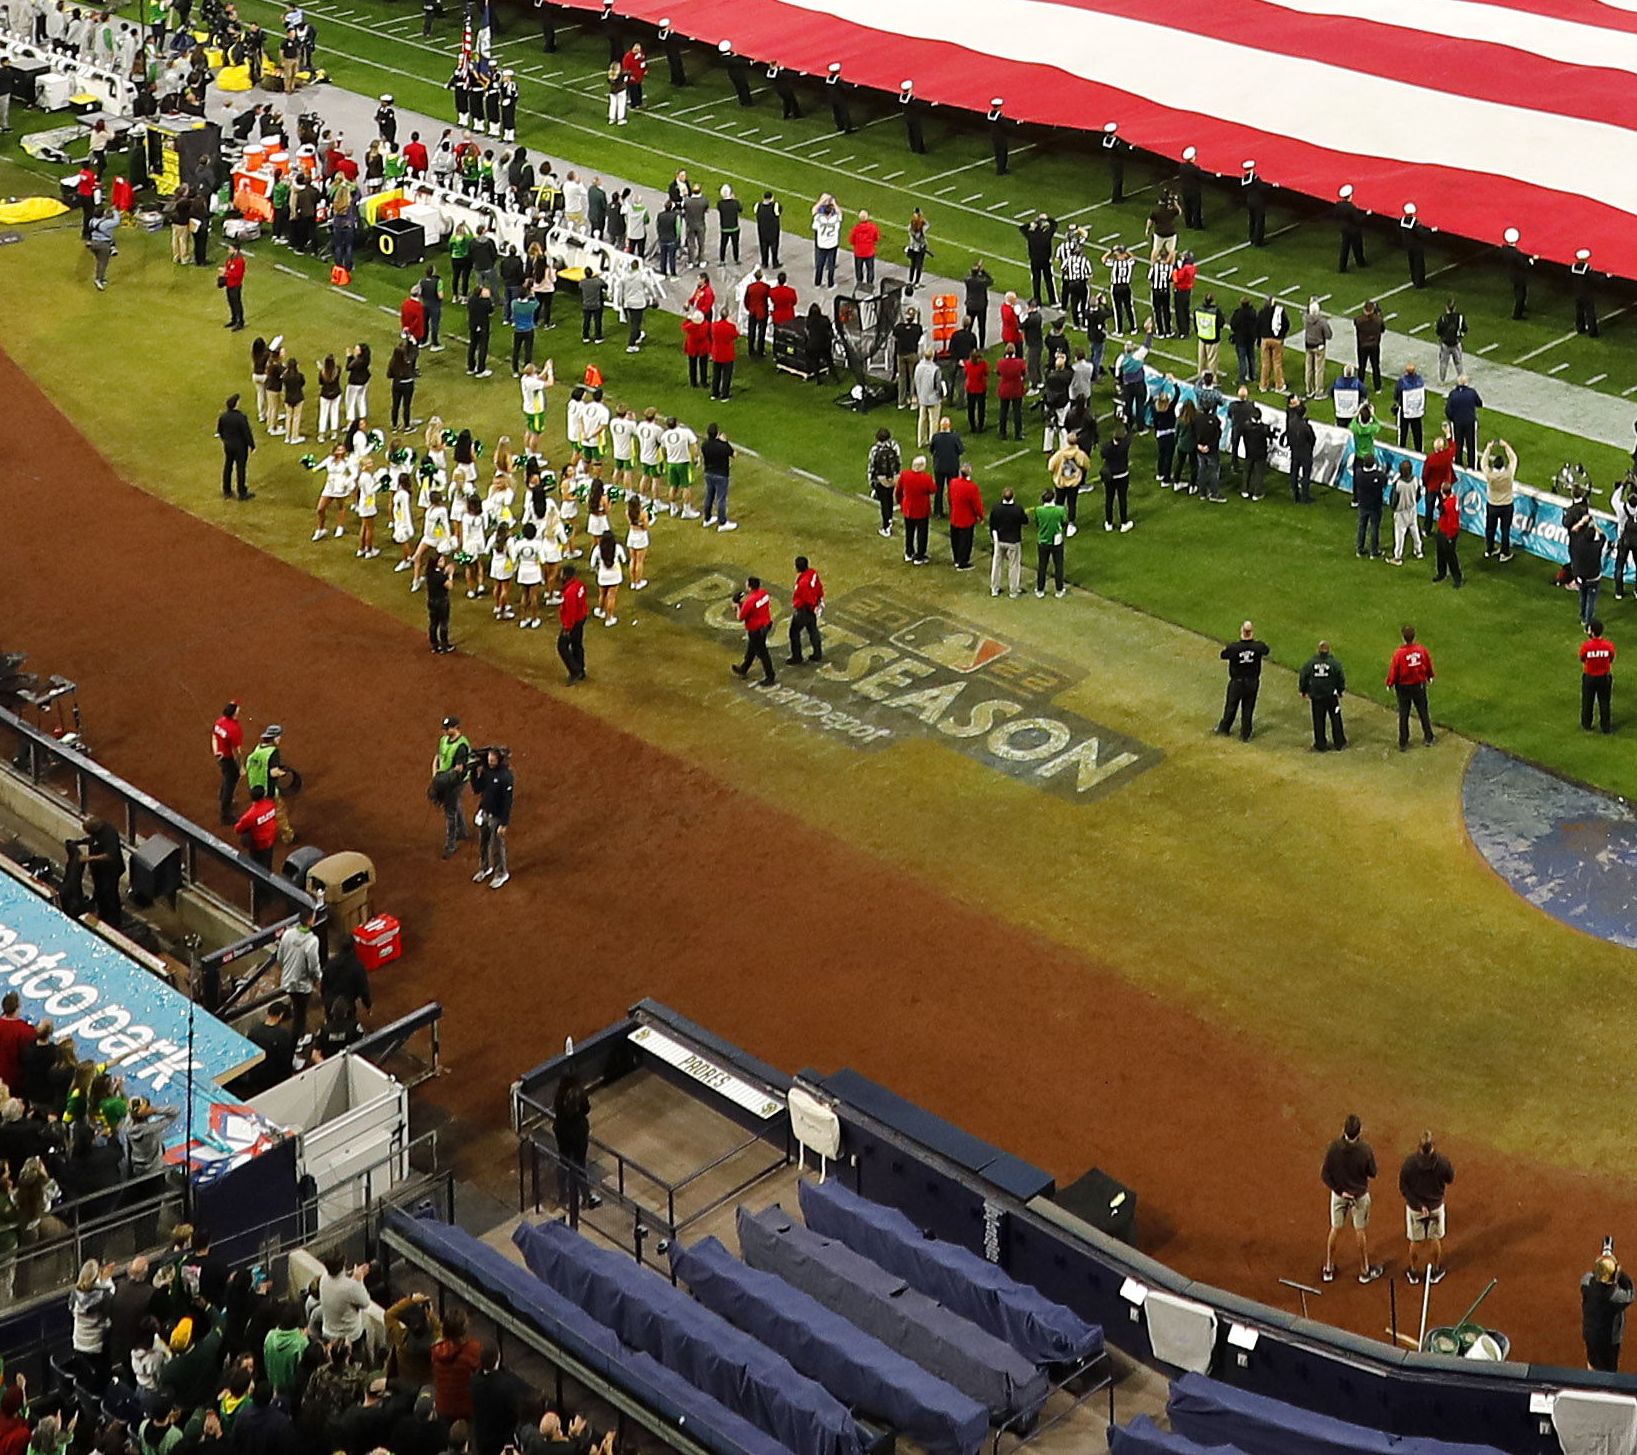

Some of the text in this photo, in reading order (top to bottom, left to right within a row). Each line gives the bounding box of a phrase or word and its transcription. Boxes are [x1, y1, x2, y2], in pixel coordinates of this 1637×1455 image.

[820, 223, 838, 236] 72
[52, 1003, 205, 1093] park
[678, 1053, 733, 1088] PADRES
